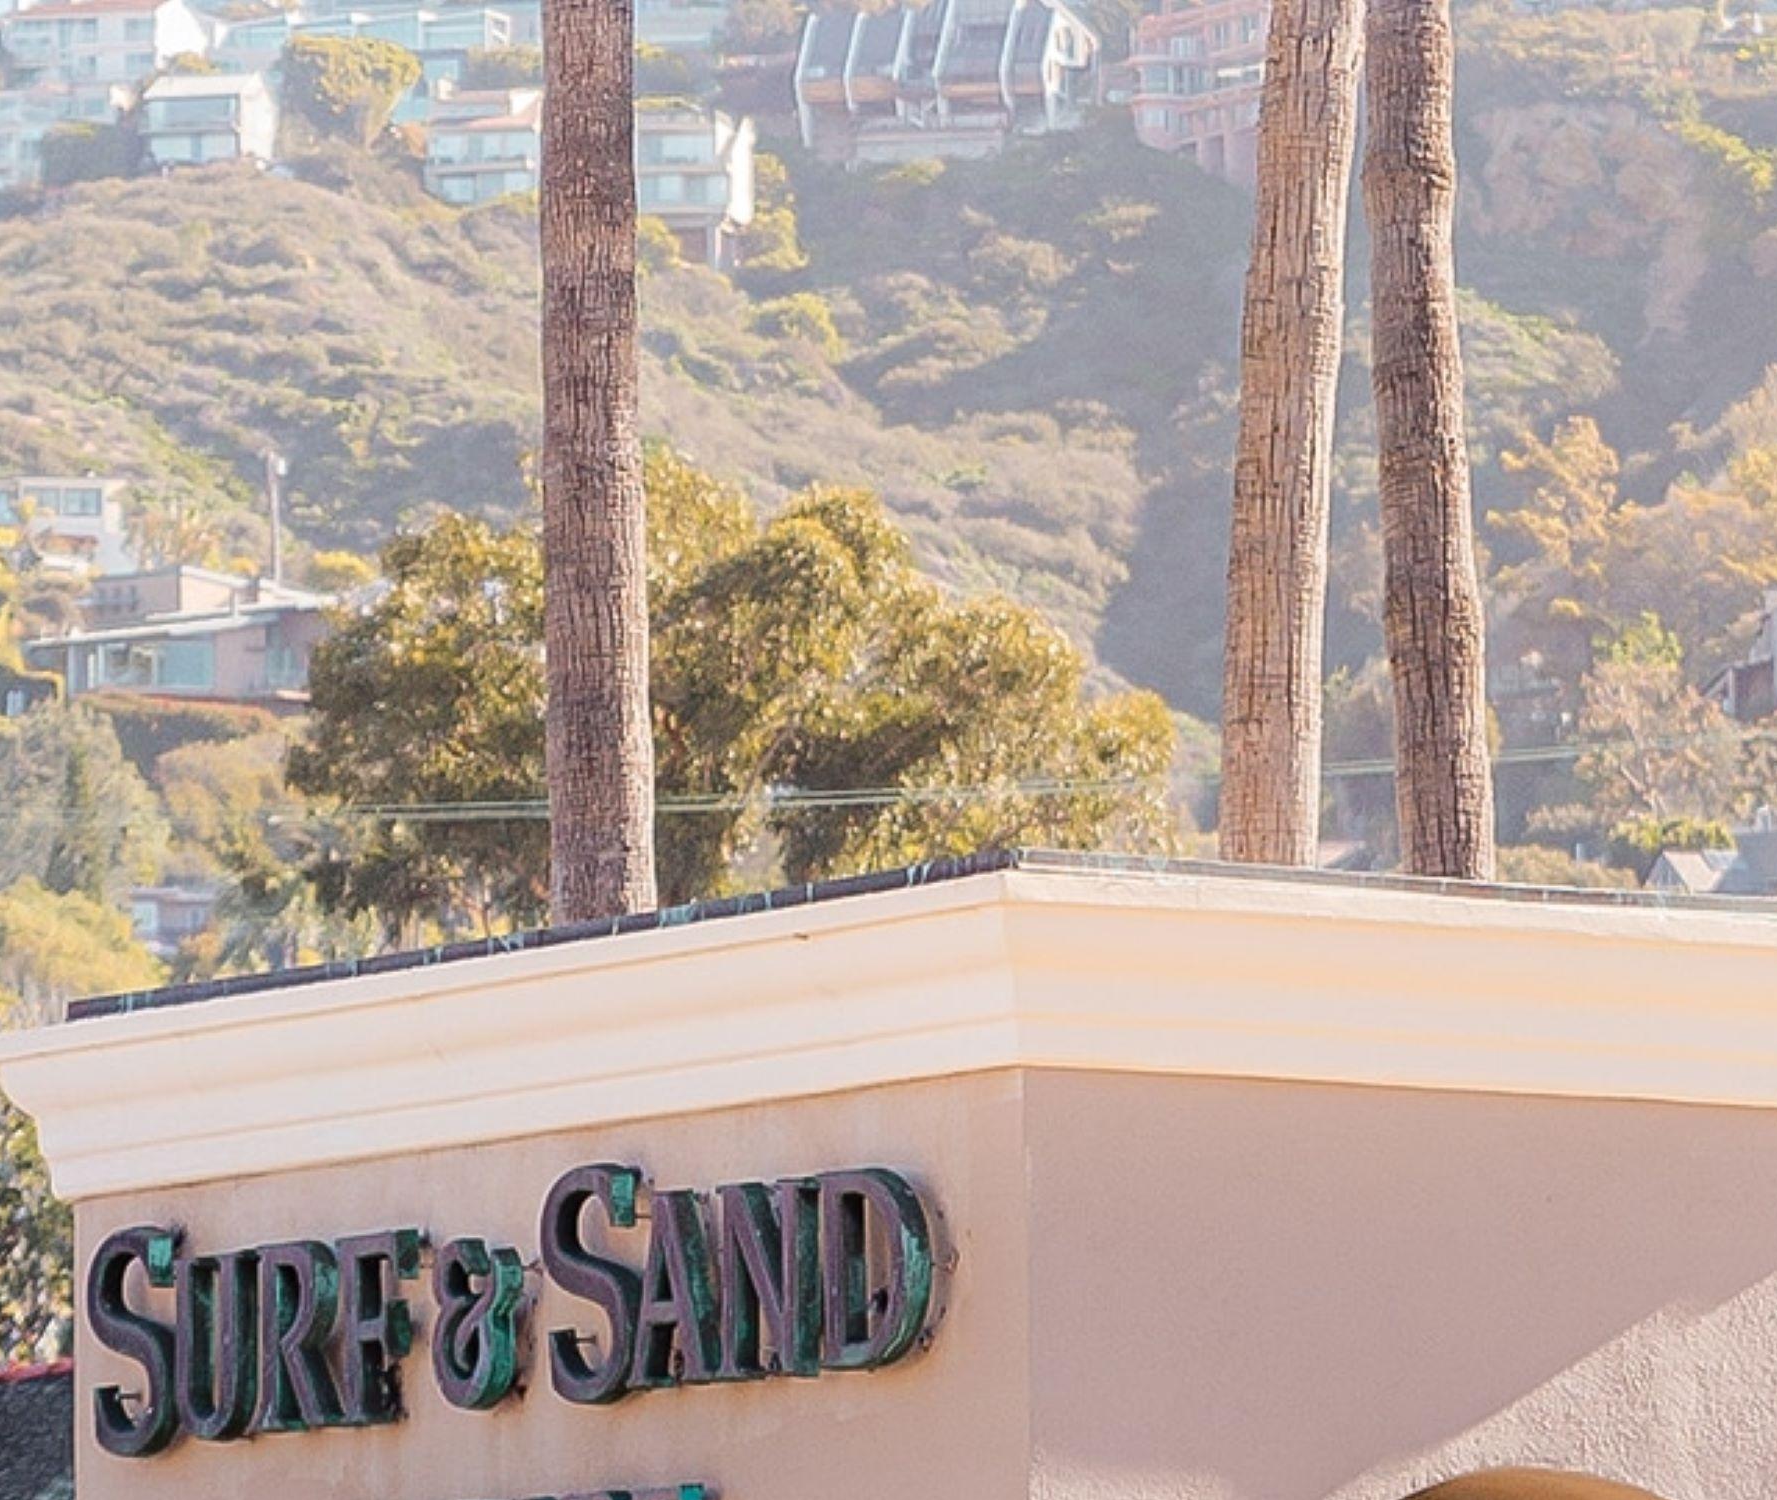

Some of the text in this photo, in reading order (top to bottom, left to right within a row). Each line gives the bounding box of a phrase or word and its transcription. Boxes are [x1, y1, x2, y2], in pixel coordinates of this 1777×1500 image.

[87, 1161, 937, 1458] SURF & SAND
